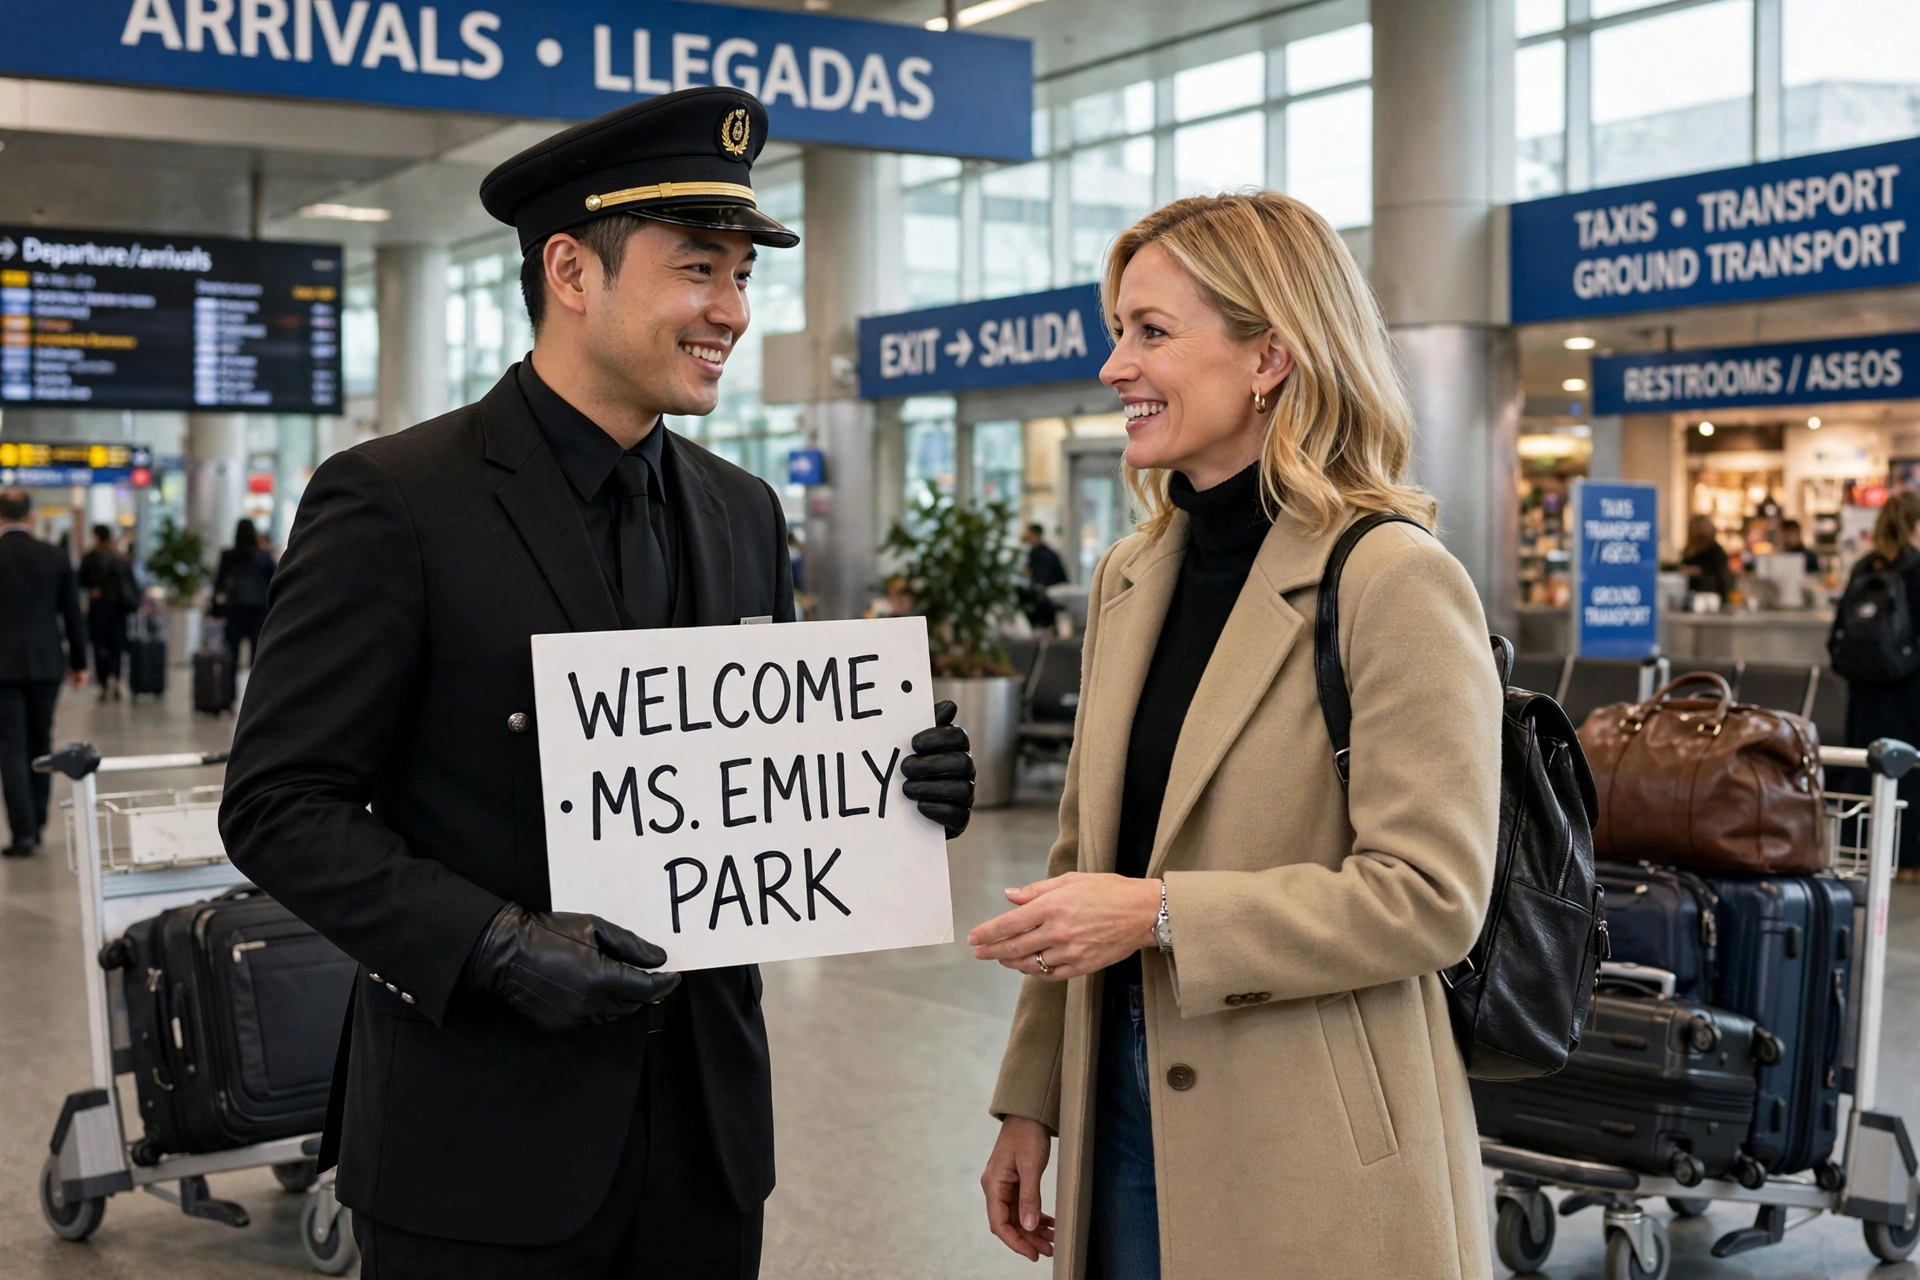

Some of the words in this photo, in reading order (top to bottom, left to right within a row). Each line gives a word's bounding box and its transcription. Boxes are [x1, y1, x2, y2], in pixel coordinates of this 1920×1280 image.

[120, 0, 504, 80] ARRIVALS
[594, 25, 935, 120] LLEGADAS
[1574, 201, 1658, 250] TAXIS
[1697, 165, 1900, 232] TRANSPORT
[22, 236, 213, 272] Departure/arrivals
[1573, 248, 1700, 299] GROUND
[1706, 220, 1906, 284] TRANSPORT
[880, 327, 941, 379] EXIT
[978, 309, 1088, 368] SALIDA
[1623, 357, 1783, 402] RESTROOMS
[1806, 349, 1903, 391] ASEOS
[568, 654, 883, 740] WELCOME
[592, 764, 700, 840] MS.
[720, 747, 900, 828] EMILY
[663, 847, 852, 934] PARK
